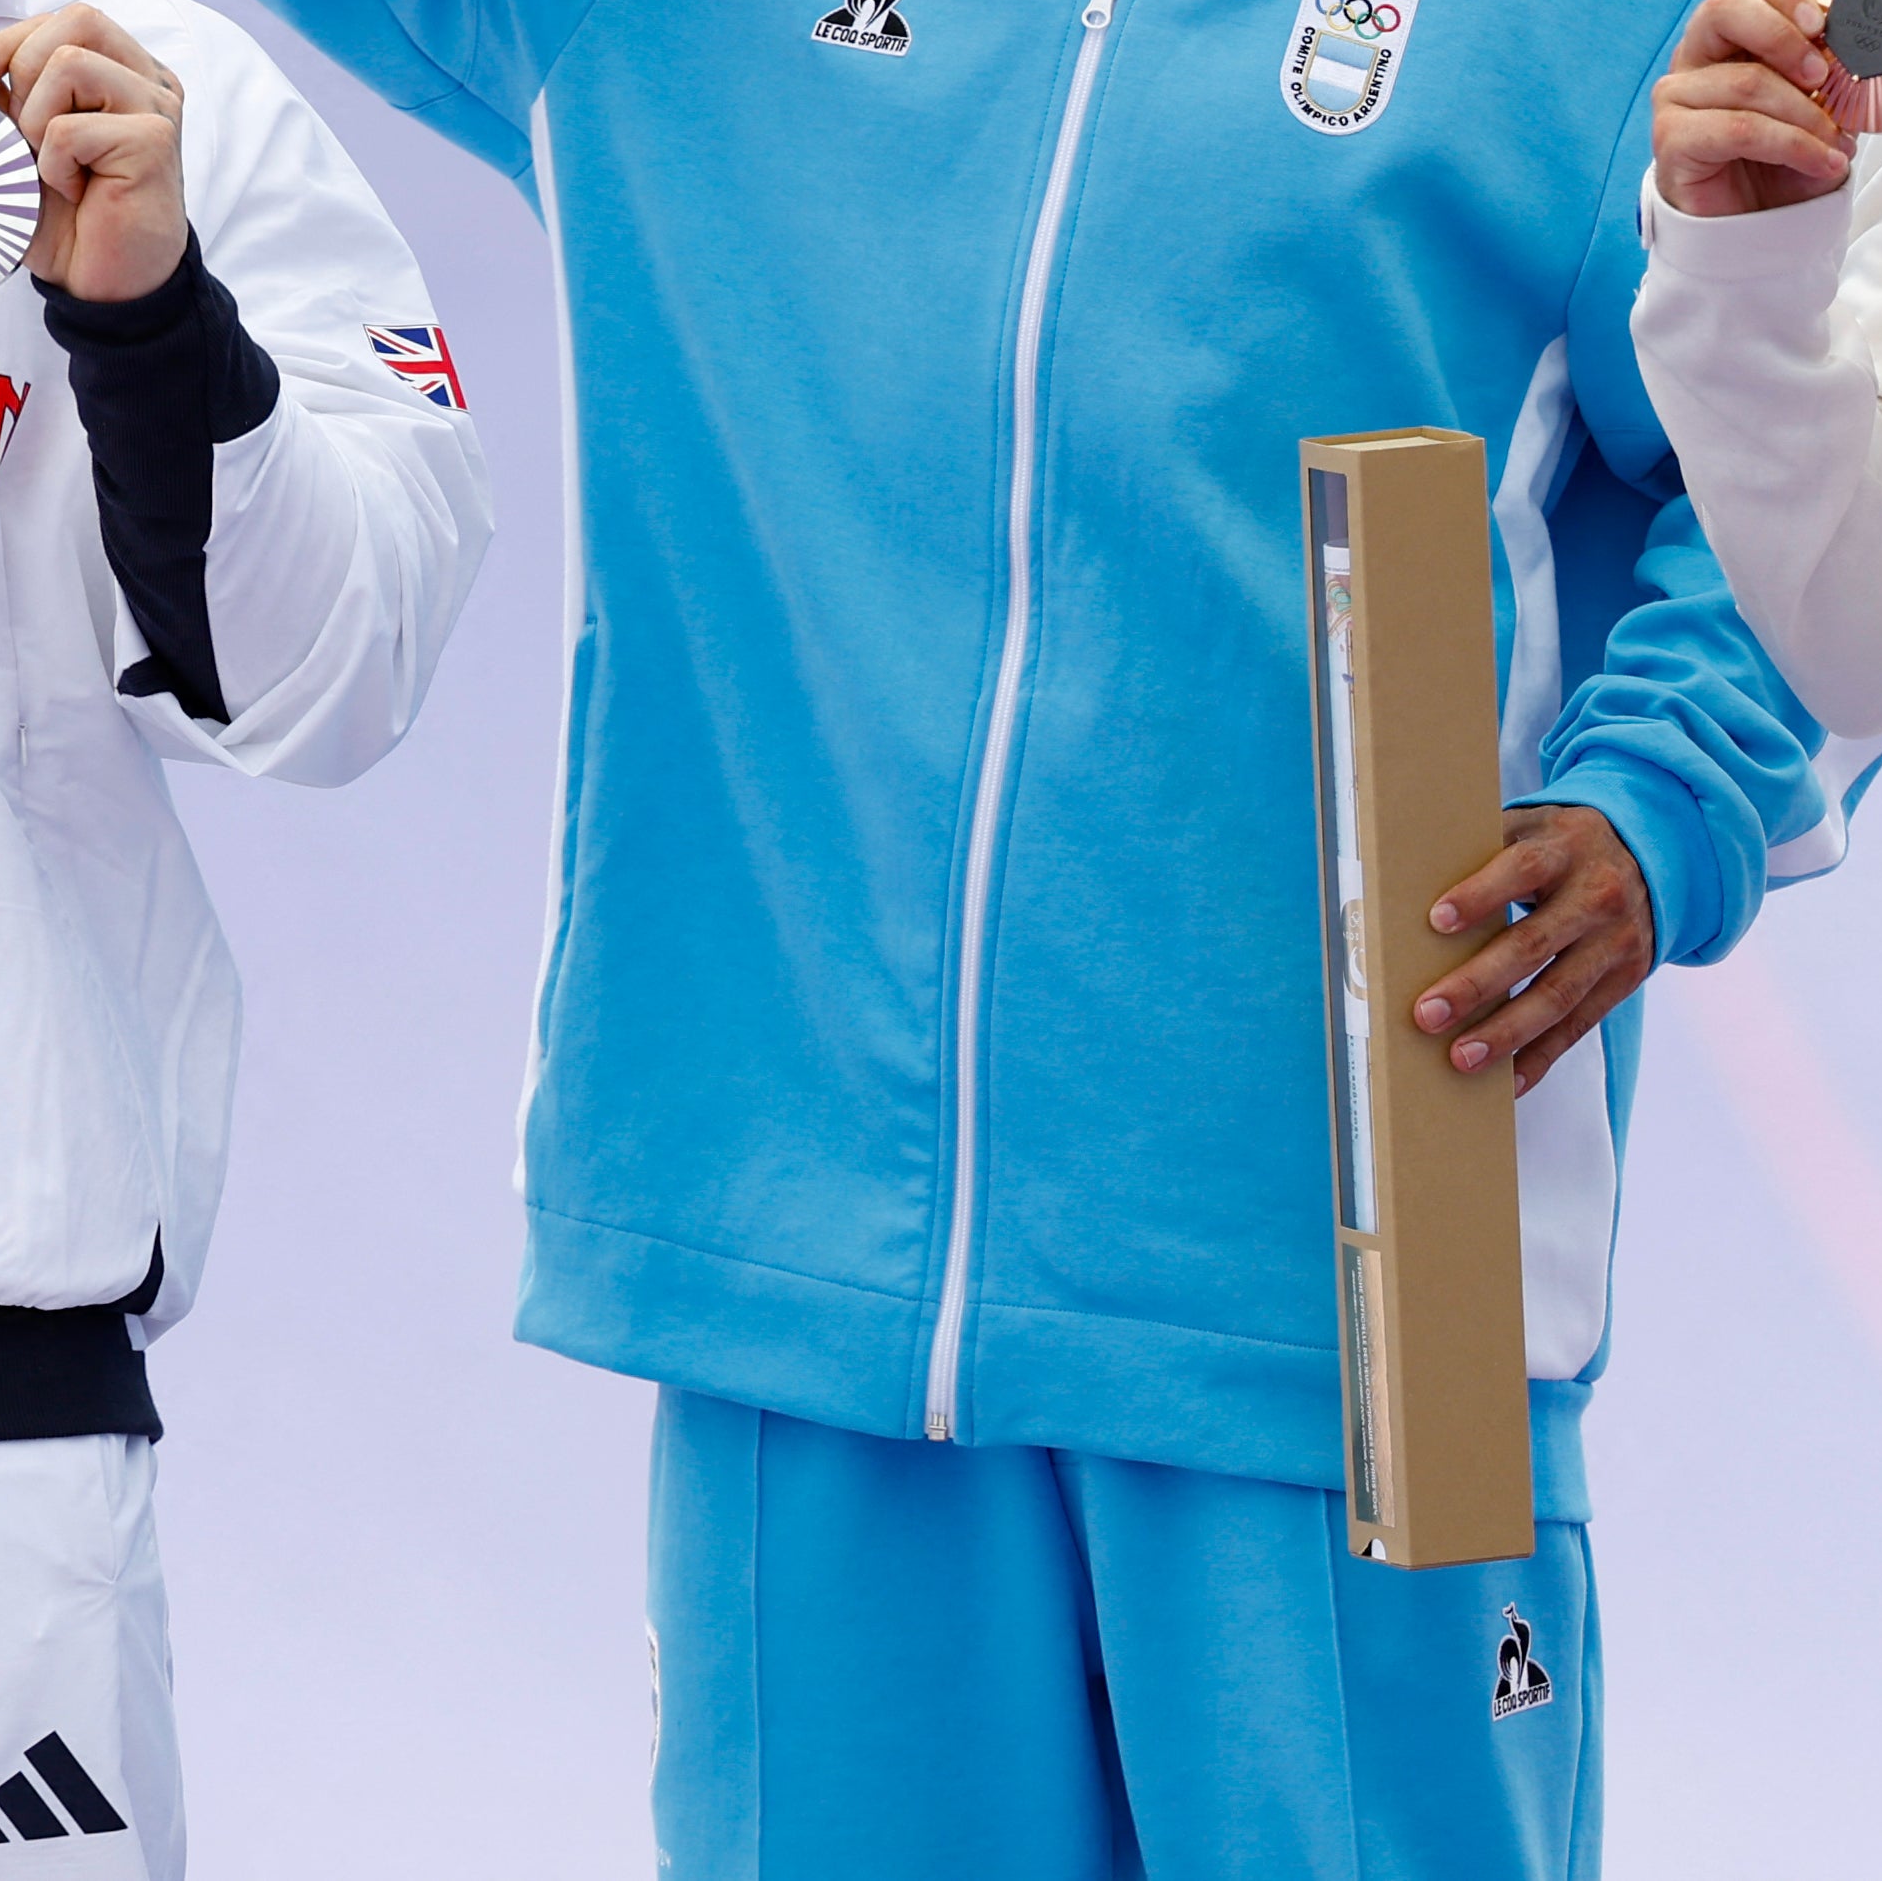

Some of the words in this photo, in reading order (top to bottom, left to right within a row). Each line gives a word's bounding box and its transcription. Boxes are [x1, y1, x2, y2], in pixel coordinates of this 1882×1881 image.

[816, 22, 830, 38] LE
[831, 26, 857, 44] COQ
[858, 31, 909, 53] SPORTIF
[1292, 26, 1316, 75] COMITE
[1290, 82, 1349, 126] OLIMPICO
[1354, 48, 1392, 122] ARGENTINO
[1494, 1699, 1502, 1717] LE
[1503, 1693, 1517, 1713] COQ
[1518, 1684, 1550, 1707] SPORTIF
